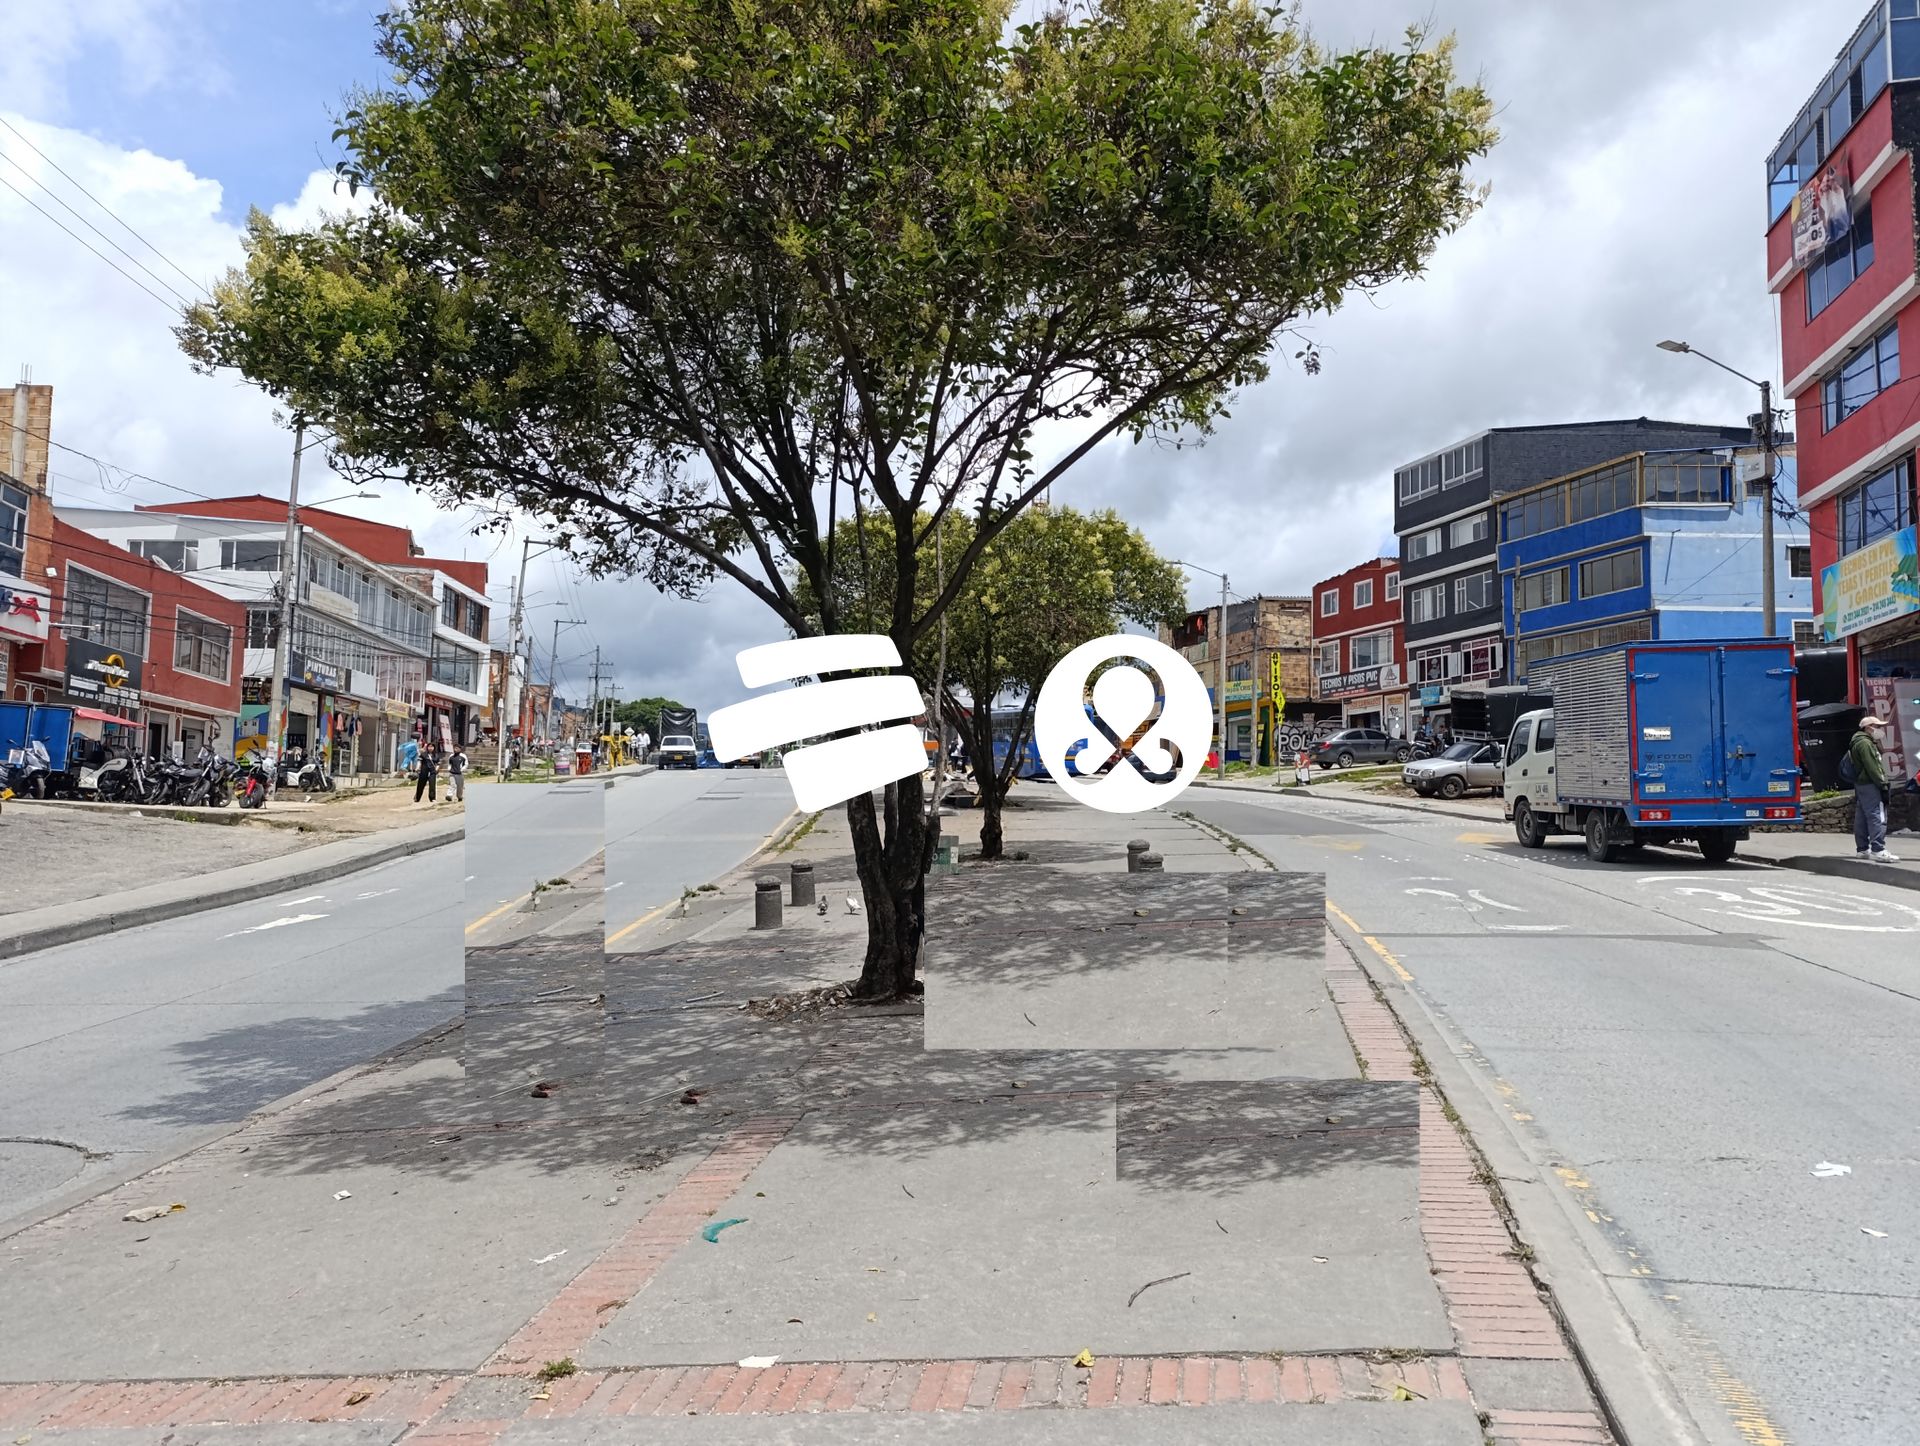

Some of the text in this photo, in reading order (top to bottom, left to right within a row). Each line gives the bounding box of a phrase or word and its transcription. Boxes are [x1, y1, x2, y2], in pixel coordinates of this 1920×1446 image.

[305, 659, 337, 678] PINTURAS
[1272, 653, 1280, 700] AVISOS
[1321, 676, 1342, 690] TECHOS
[1348, 671, 1365, 685] PISOS
[1365, 670, 1378, 682] PVC
[1866, 679, 1892, 687] TECHOS
[1873, 686, 1887, 697] EN
